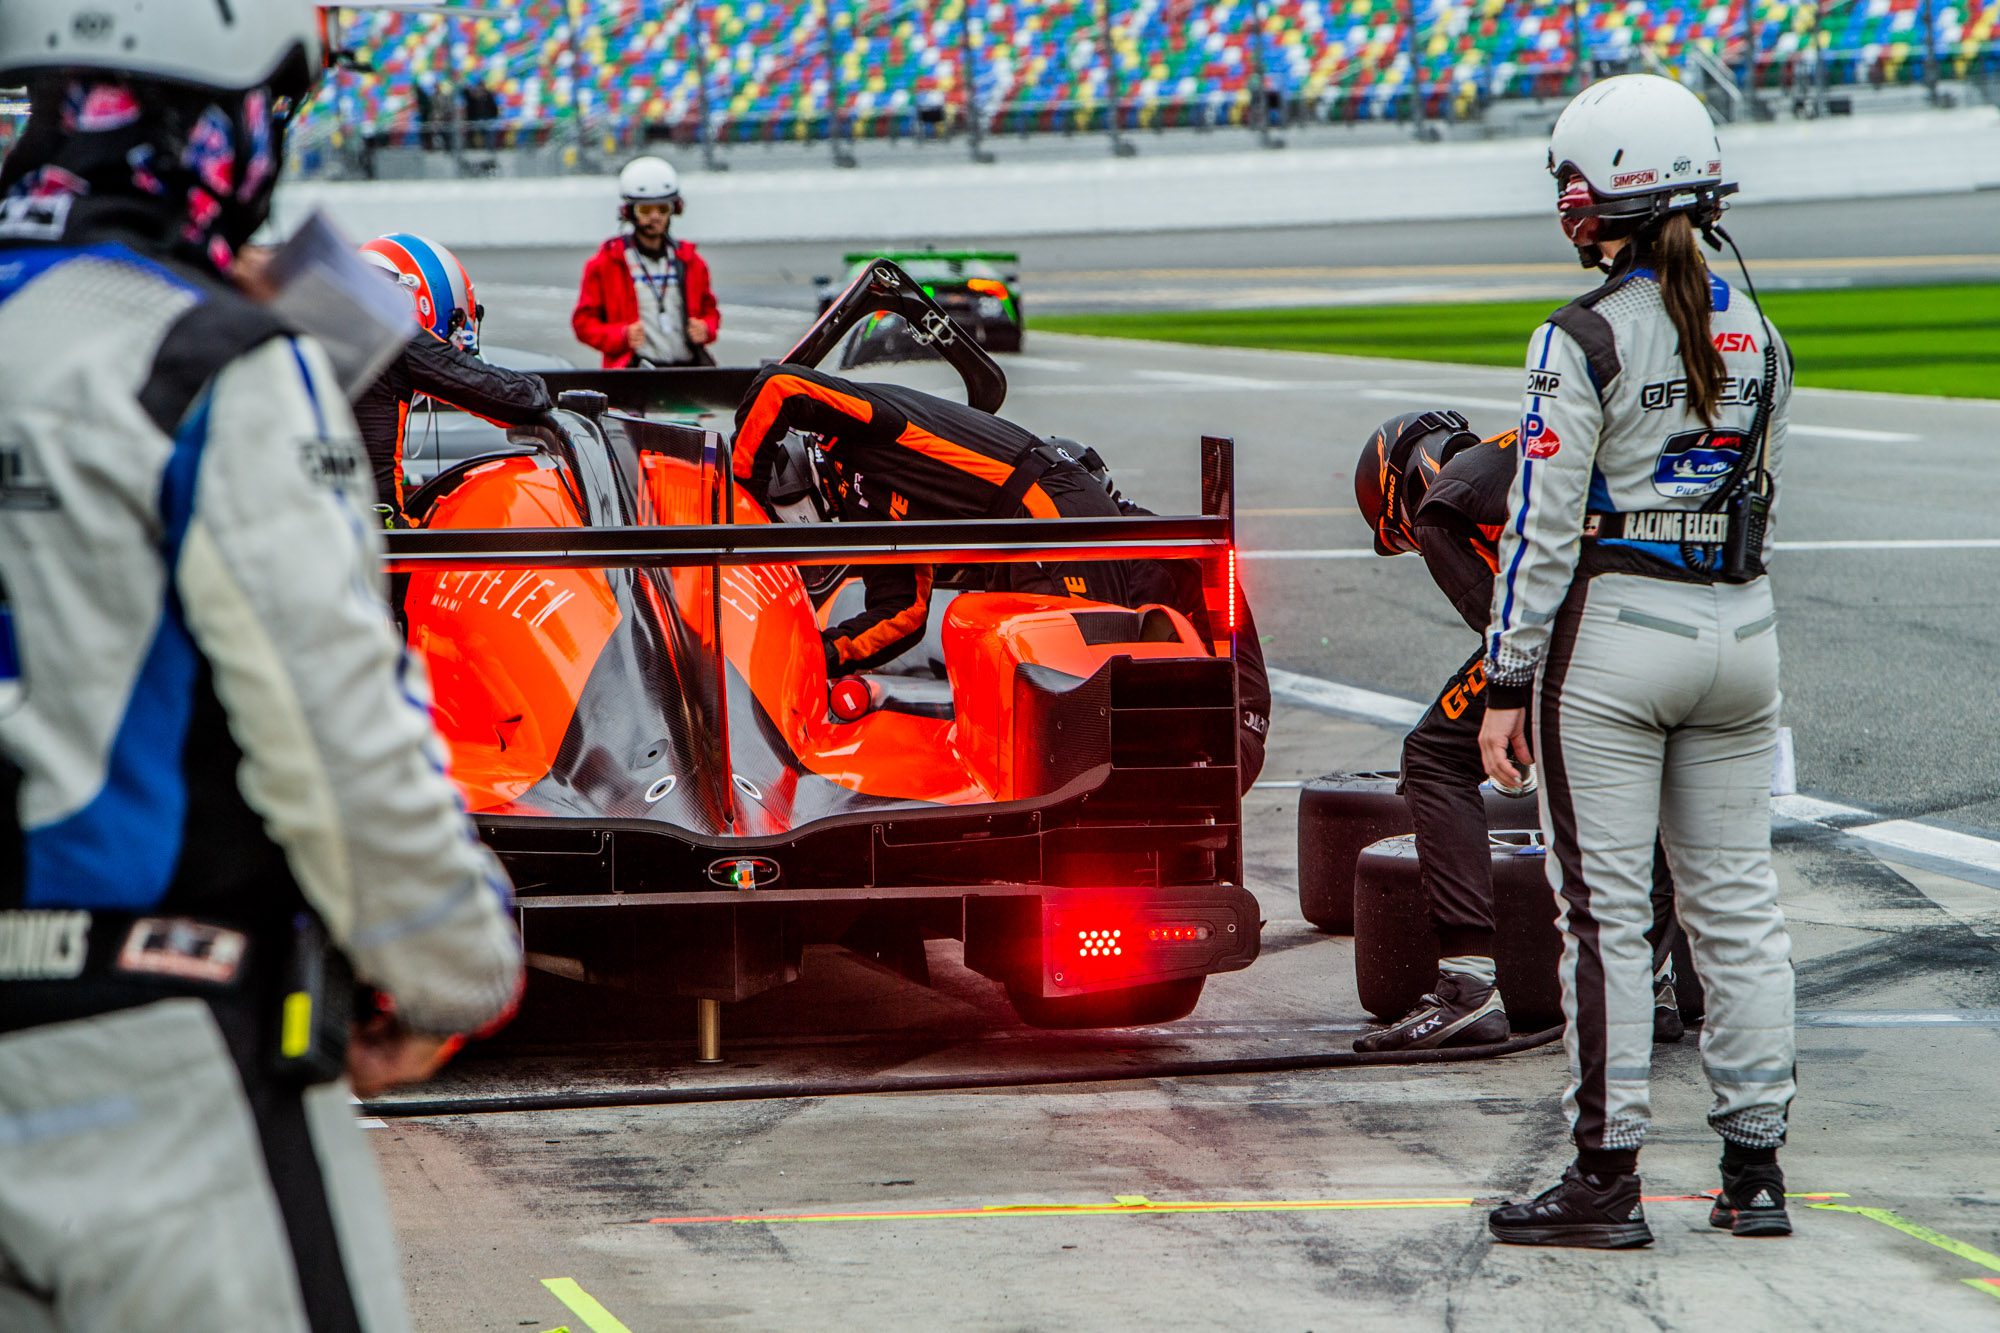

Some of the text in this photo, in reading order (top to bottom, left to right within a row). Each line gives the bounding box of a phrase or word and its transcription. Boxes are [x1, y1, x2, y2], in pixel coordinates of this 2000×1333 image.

[1673, 160, 1692, 172] DOT
[1613, 171, 1655, 187] SIMPSON
[1712, 332, 1759, 354] MSA
[1623, 511, 1683, 542] RACING
[1684, 513, 1730, 543] ELECT
[430, 593, 463, 613] MIAMI
